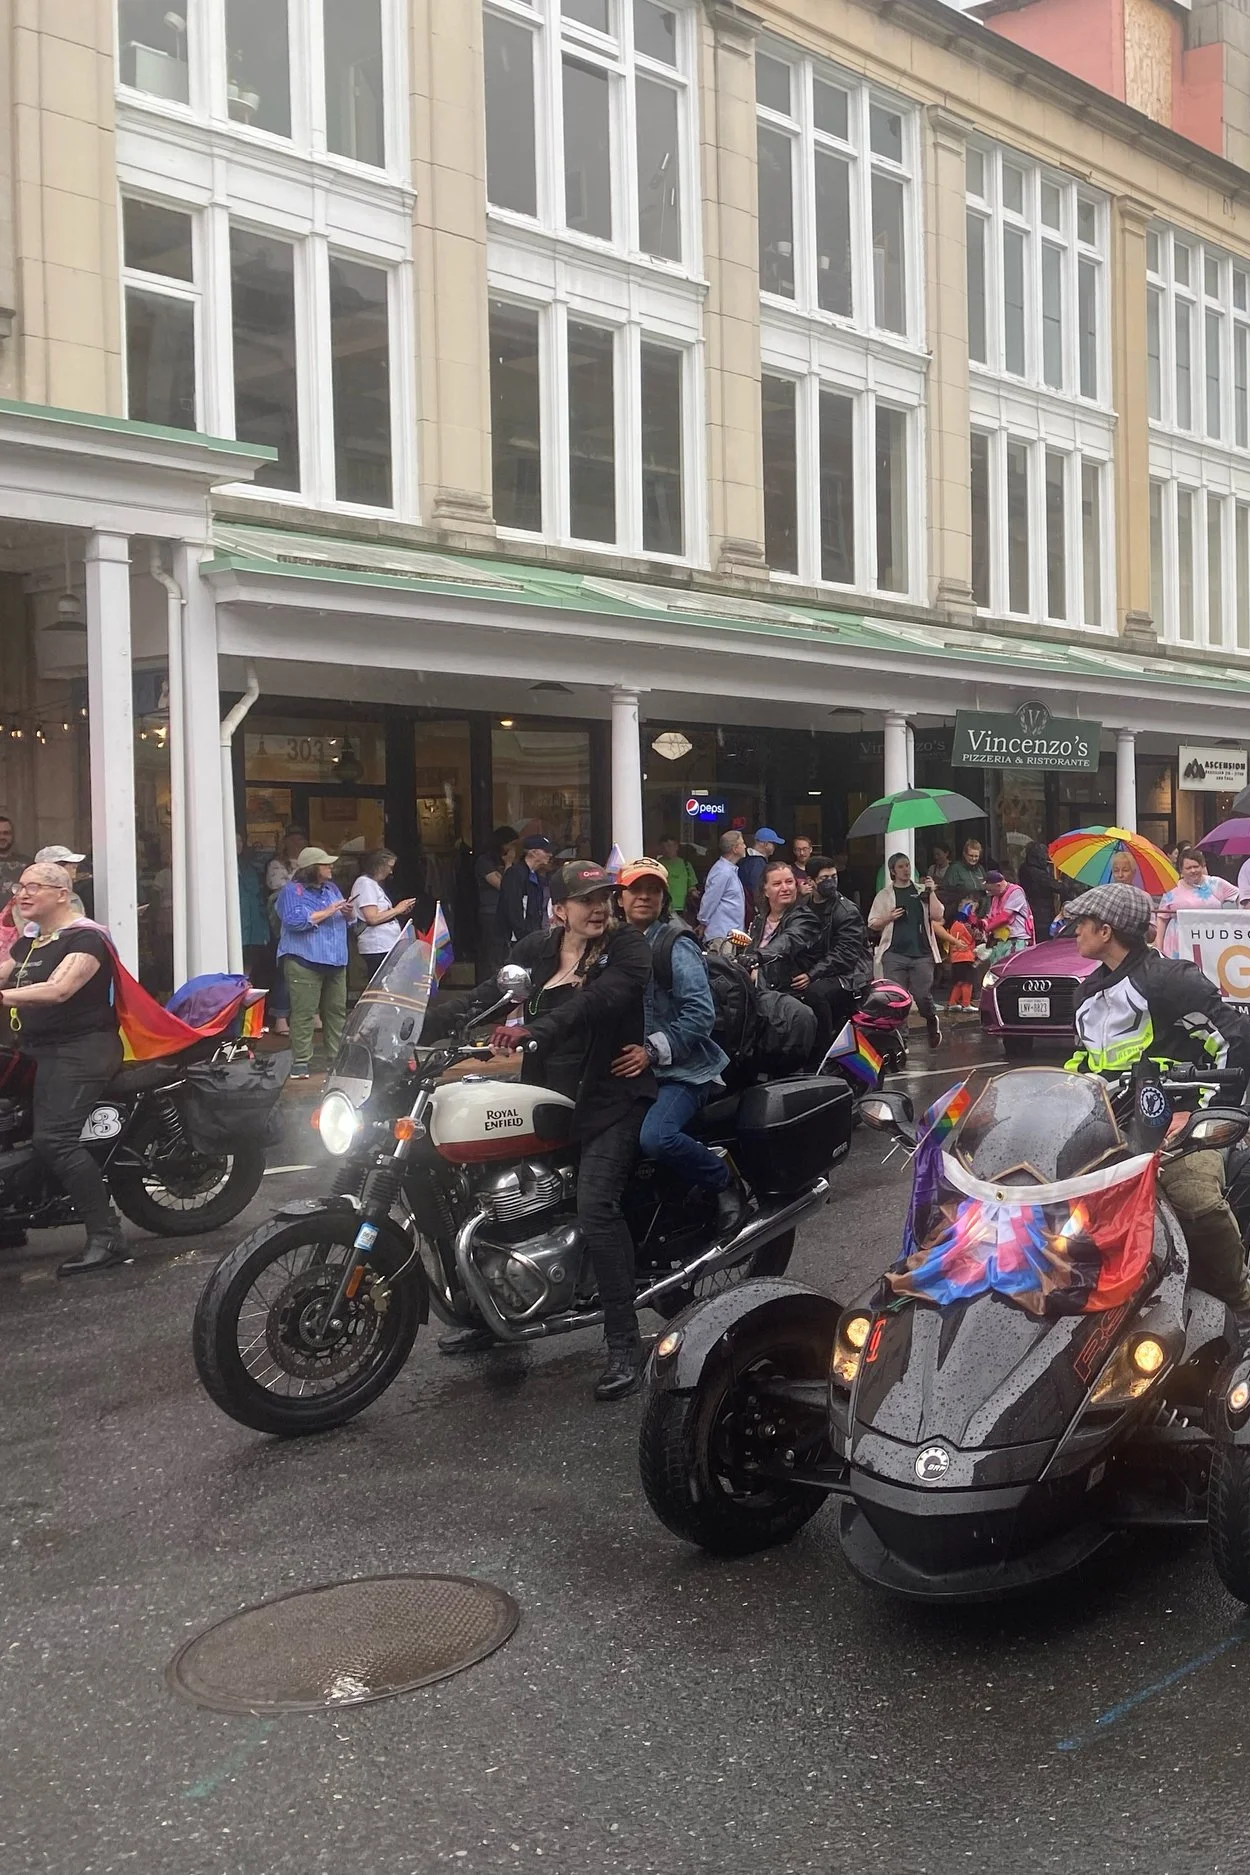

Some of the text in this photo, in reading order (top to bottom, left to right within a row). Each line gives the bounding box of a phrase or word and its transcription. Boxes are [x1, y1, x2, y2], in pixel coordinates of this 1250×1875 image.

[967, 729, 1089, 757] Vincenzo's
[962, 754, 1012, 764] PIZZERIA
[1026, 756, 1091, 767] RISTORANTE
[1205, 761, 1246, 770] ASCENSION
[700, 803, 725, 814] pepsi
[486, 1109, 519, 1120] ROYAL
[484, 1117, 524, 1131] ENFIELD
